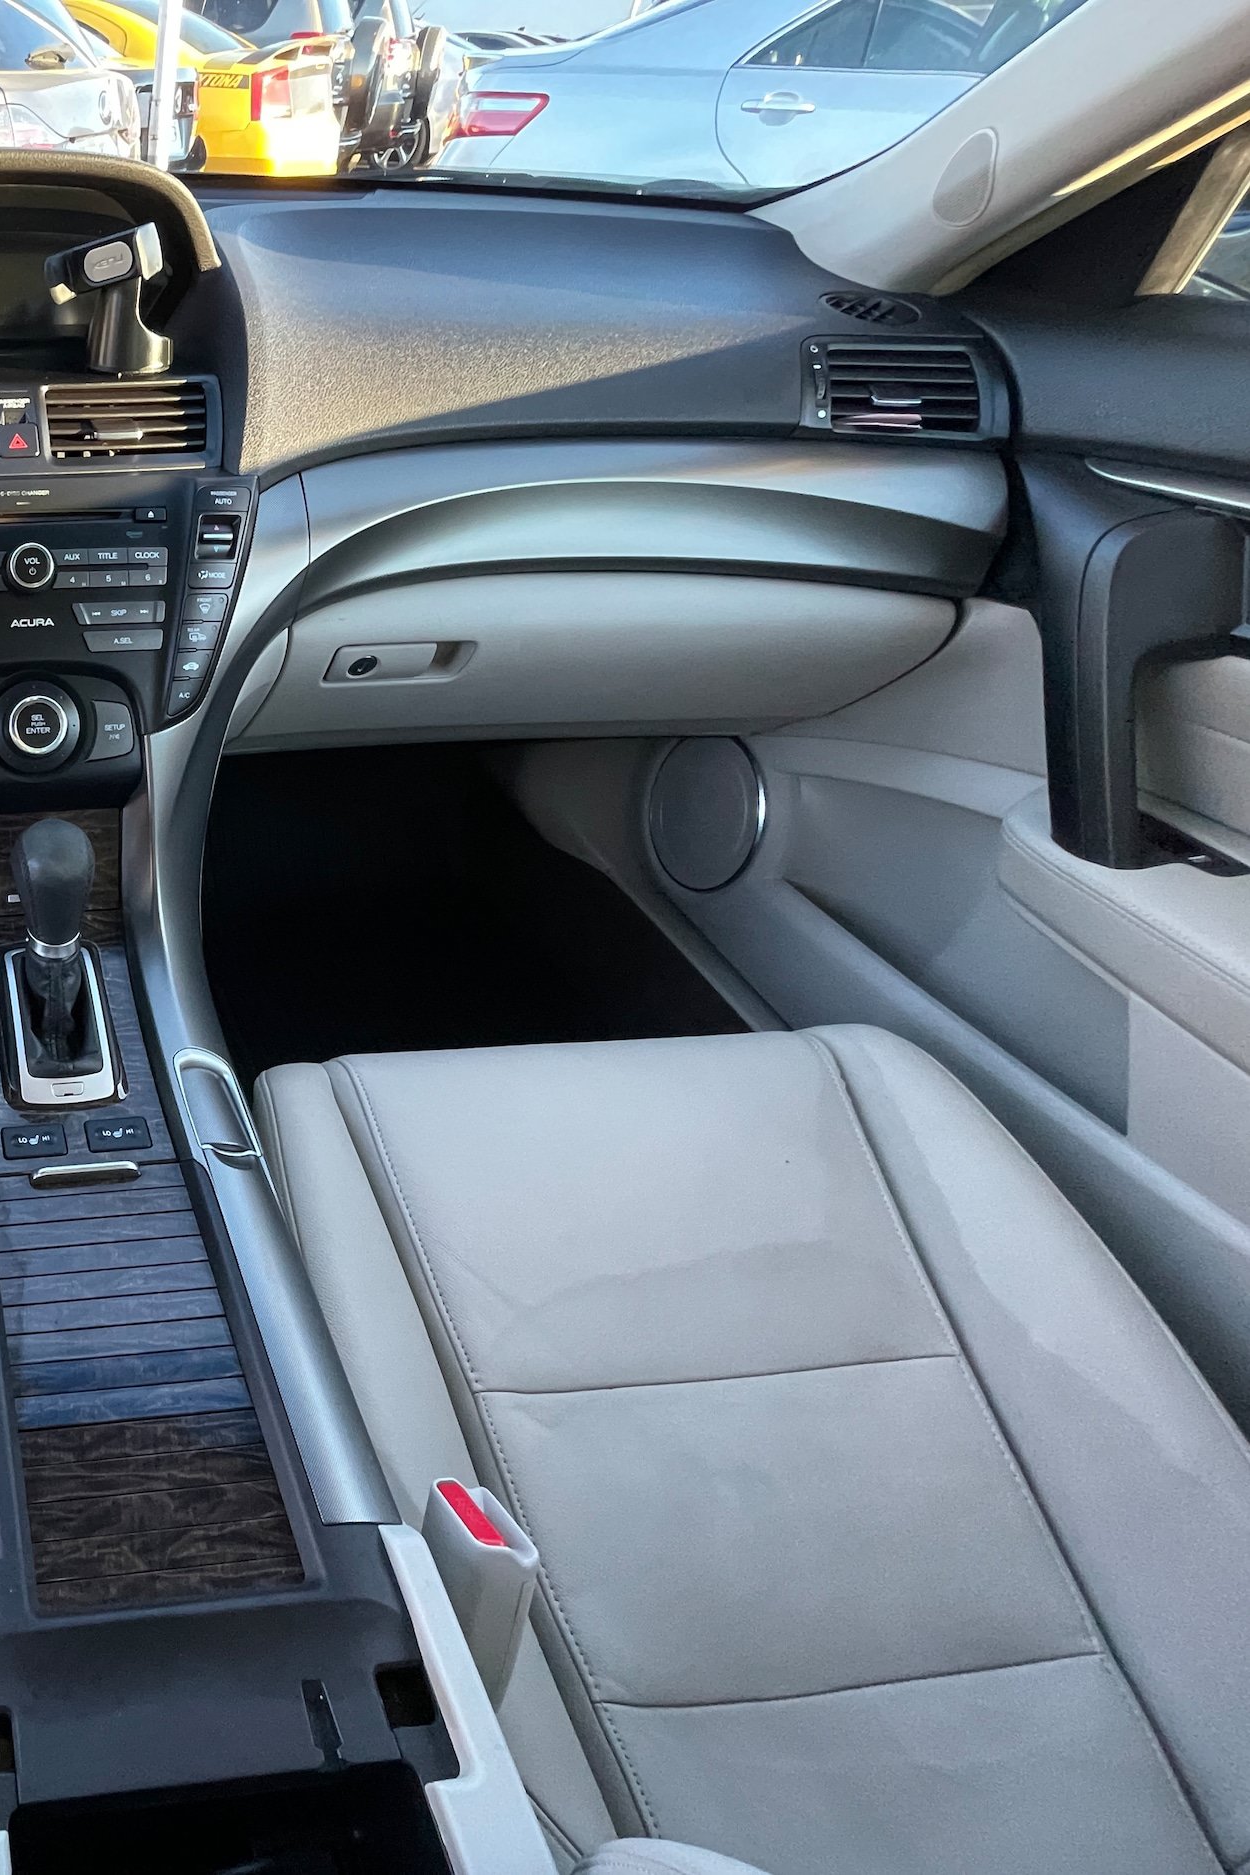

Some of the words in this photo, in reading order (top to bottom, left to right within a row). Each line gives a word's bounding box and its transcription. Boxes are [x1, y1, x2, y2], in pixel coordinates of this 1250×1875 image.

[197, 73, 243, 88] YTONA
[64, 553, 80, 561] AUX
[98, 552, 118, 560] TITLE
[135, 551, 160, 559] CLOCK
[24, 557, 40, 565] VOL
[70, 576, 76, 584] 4
[106, 574, 112, 582] 5
[145, 574, 150, 582] 6
[111, 609, 127, 617] SKIP
[10, 618, 54, 628] ACURA
